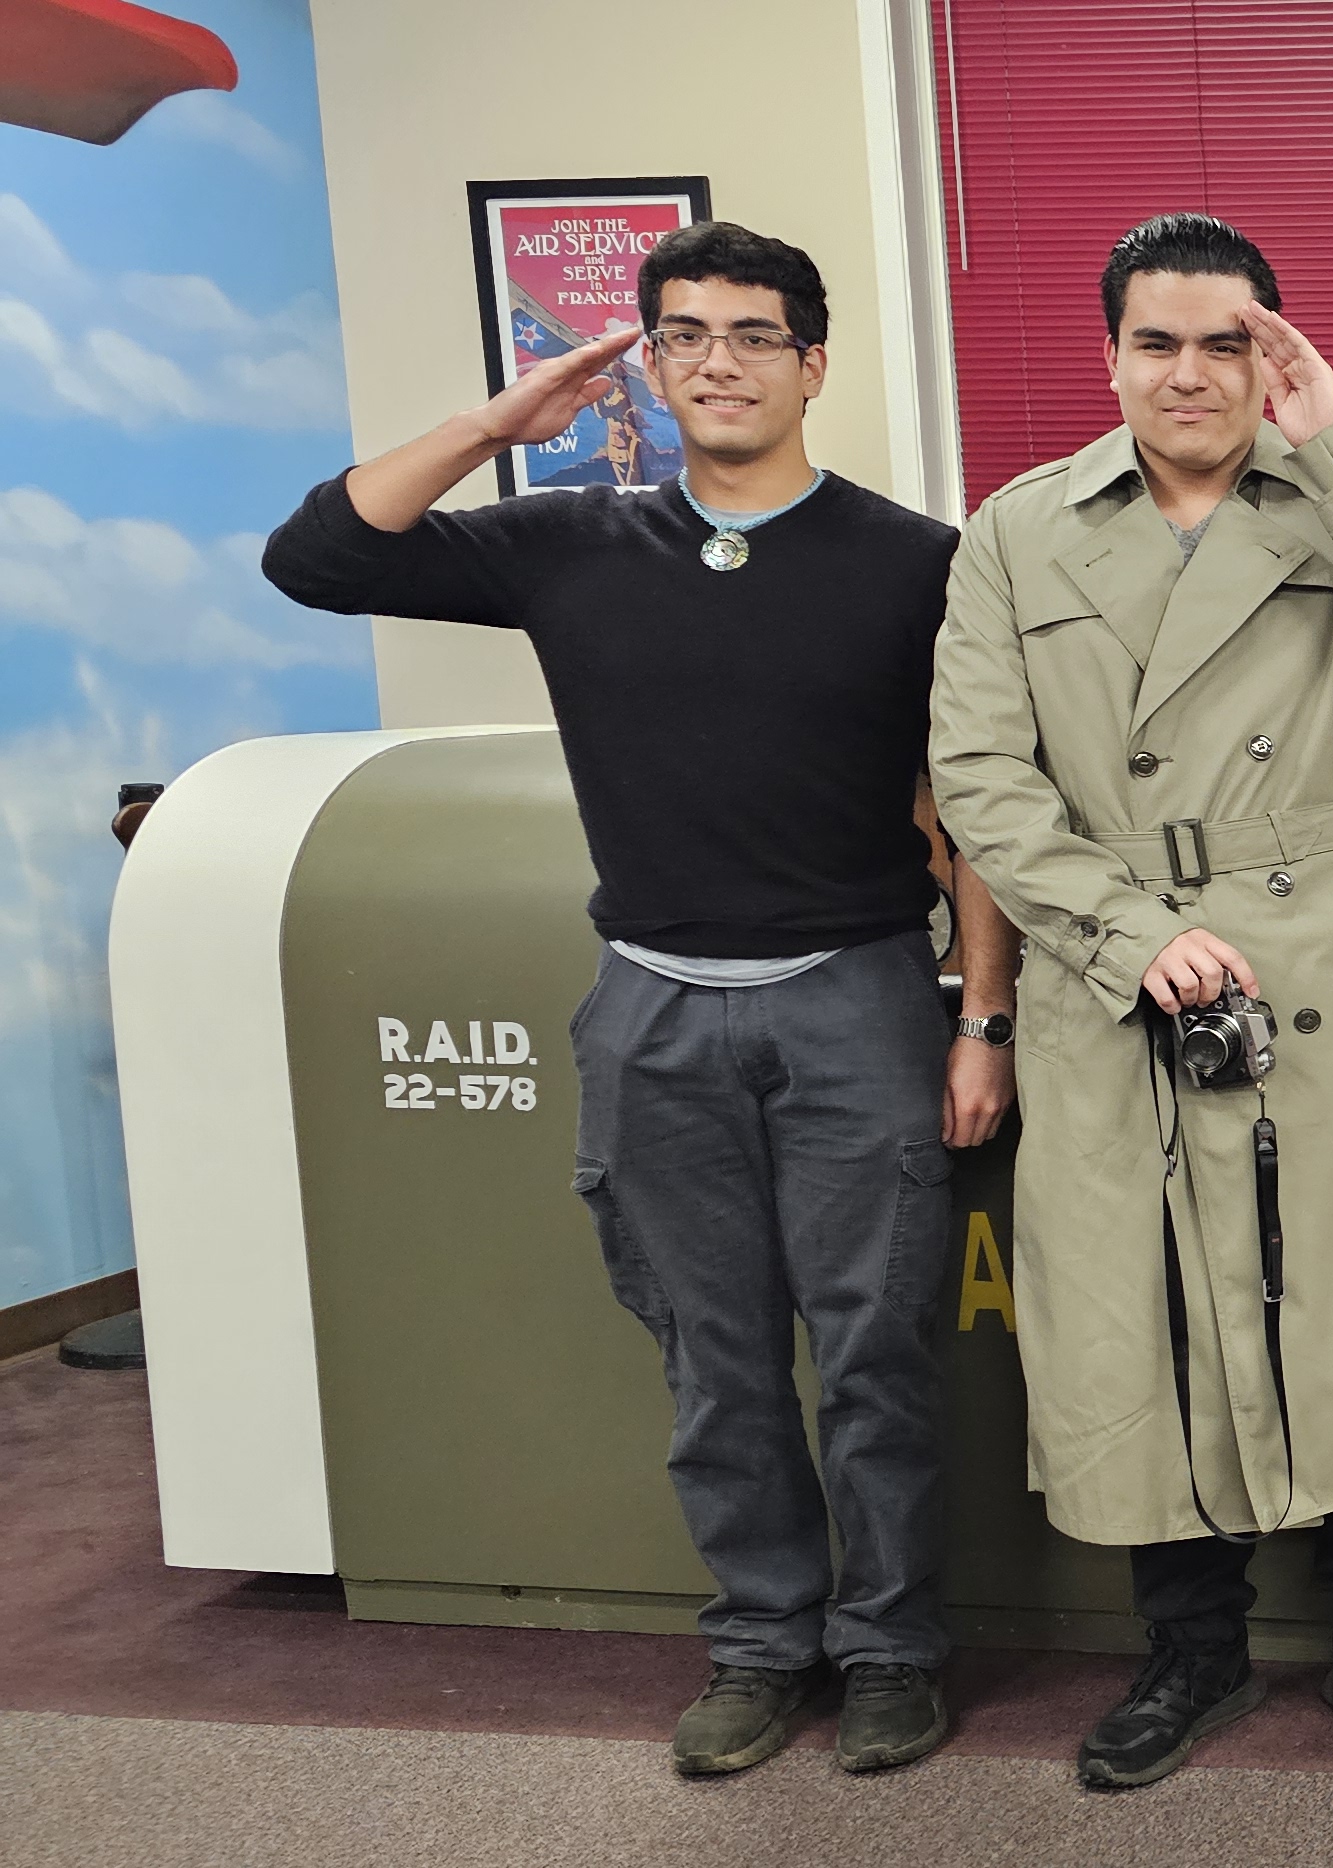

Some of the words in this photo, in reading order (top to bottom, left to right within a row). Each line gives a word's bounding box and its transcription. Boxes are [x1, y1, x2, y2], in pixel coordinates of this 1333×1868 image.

[551, 219, 590, 234] JOIN
[594, 218, 630, 232] THE
[514, 234, 560, 256] AIR
[584, 254, 605, 265] and
[563, 265, 626, 281] SERVE
[590, 279, 603, 291] in
[557, 290, 637, 305] FRANCE
[378, 1016, 538, 1065] R.A.I.D.
[383, 1073, 537, 1111] 22-578
